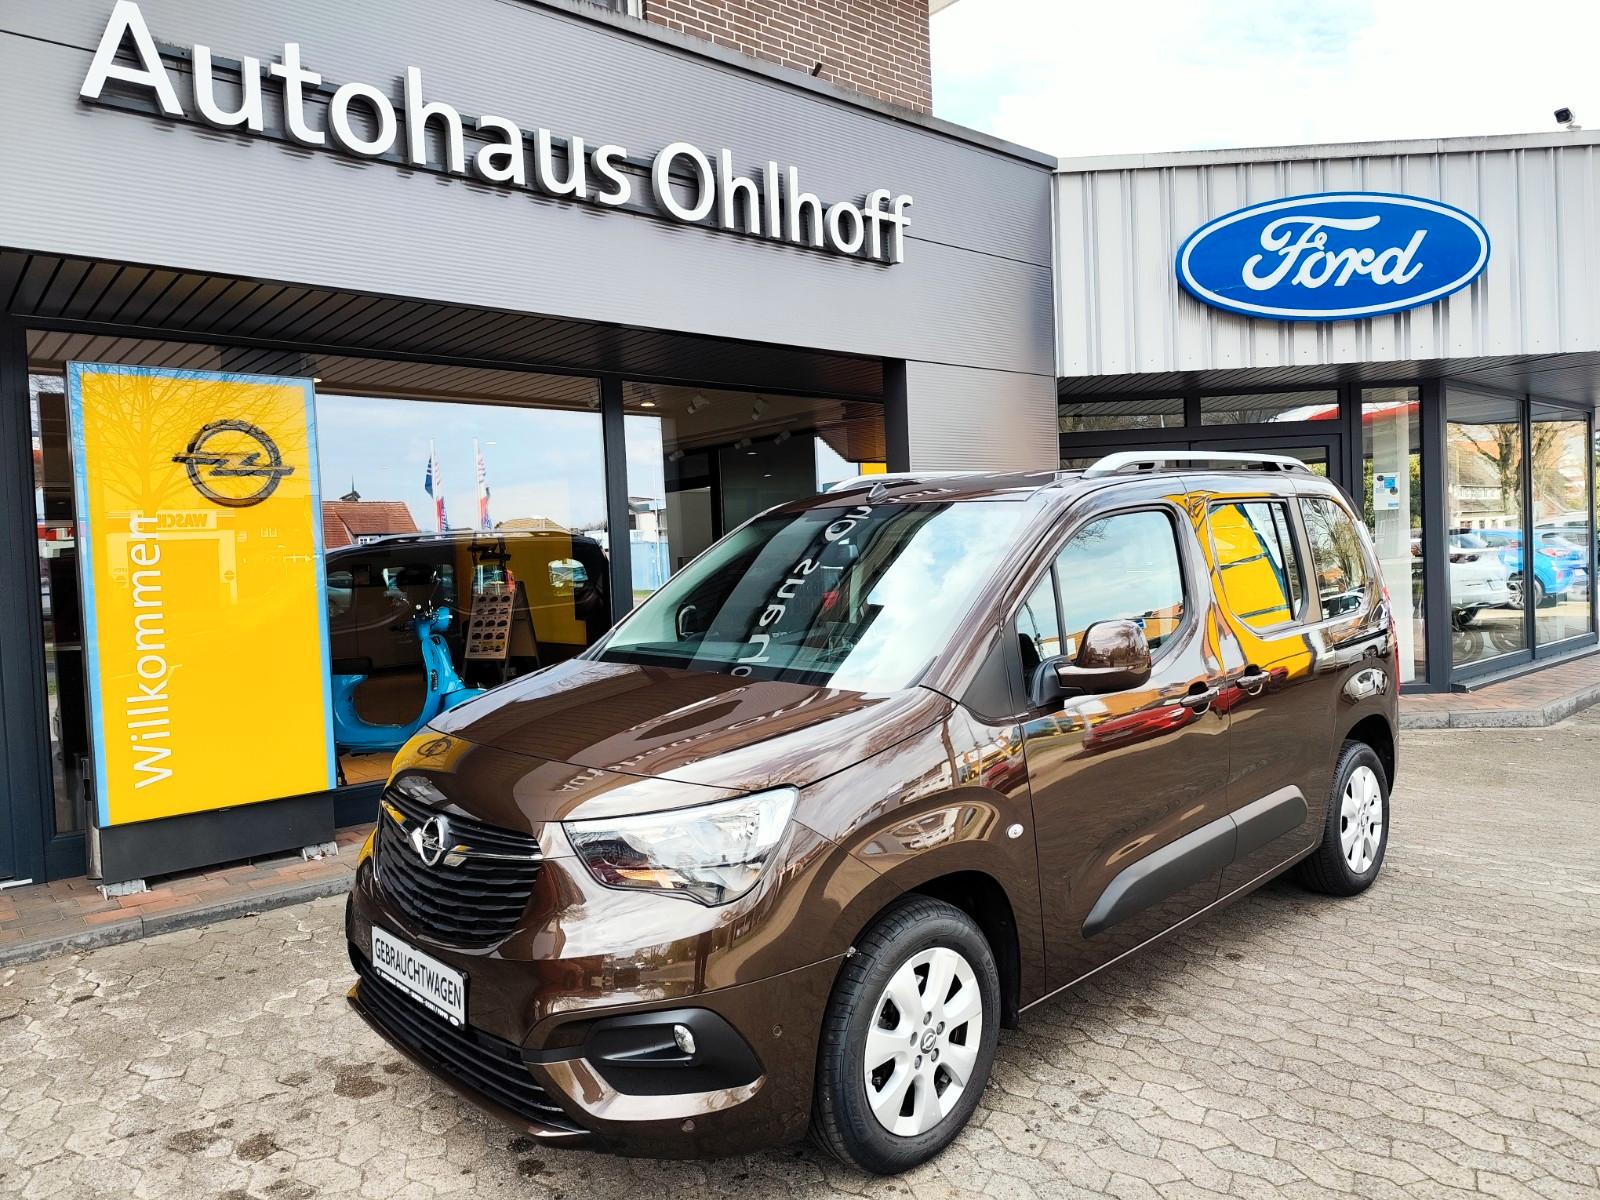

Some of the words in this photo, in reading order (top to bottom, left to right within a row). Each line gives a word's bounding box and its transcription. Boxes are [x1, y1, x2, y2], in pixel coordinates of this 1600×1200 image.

[79, 0, 633, 207] Autohaus
[651, 141, 914, 264] Ohlhoff
[1242, 215, 1428, 291] Ford
[127, 514, 173, 789] Willkommen
[374, 937, 462, 1011] GEBRAUCHTWAGEN
